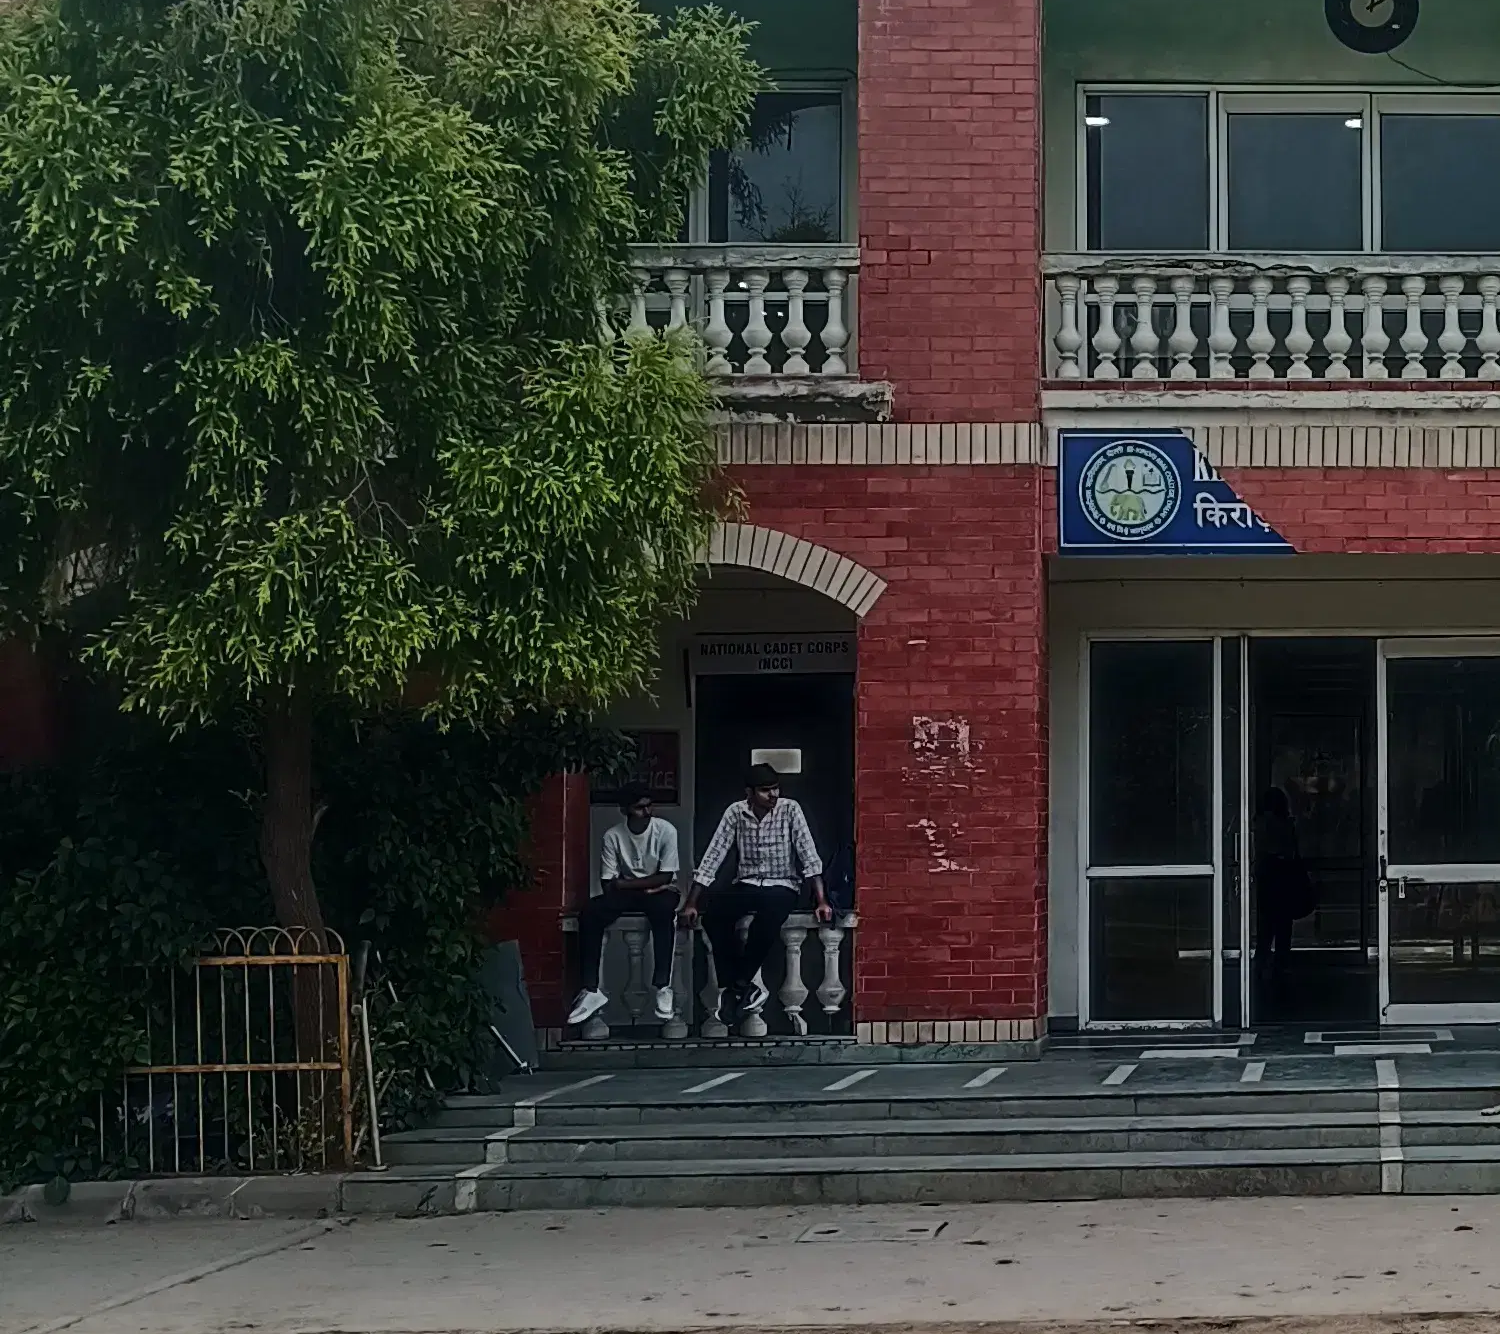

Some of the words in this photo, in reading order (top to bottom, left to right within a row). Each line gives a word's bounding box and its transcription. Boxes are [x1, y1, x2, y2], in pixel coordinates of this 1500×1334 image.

[700, 643, 760, 656] NATIONAL
[763, 642, 803, 655] CADET
[807, 641, 849, 654] CORPS
[758, 658, 793, 670] (NCC)
